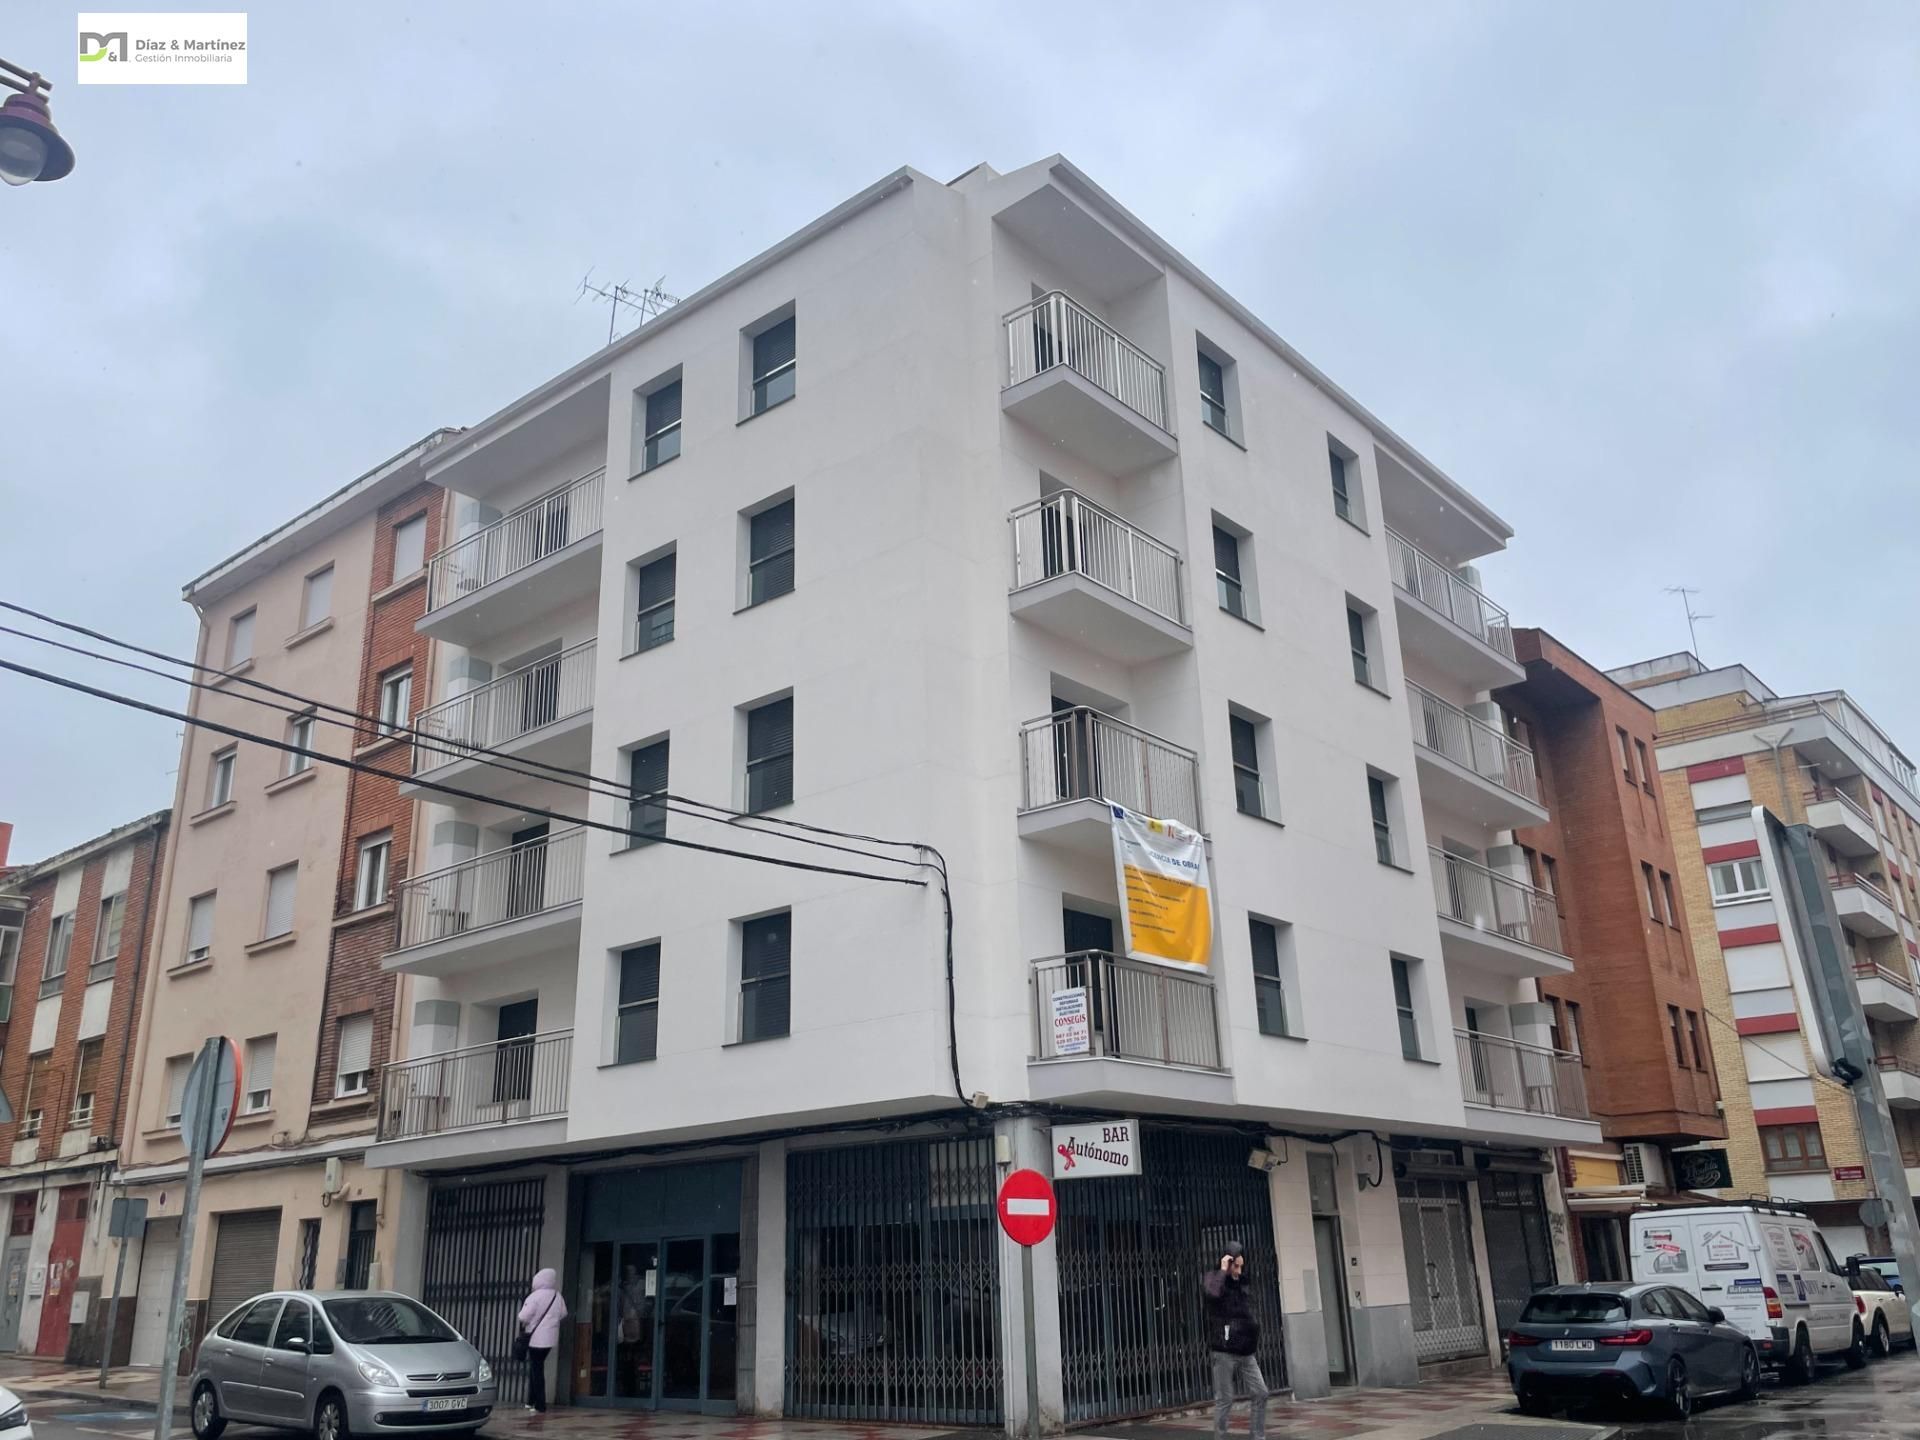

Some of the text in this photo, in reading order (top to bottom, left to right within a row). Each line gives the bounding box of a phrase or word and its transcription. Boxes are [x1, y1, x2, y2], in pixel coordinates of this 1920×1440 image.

[1055, 1014, 1086, 1028] CONSEGIS
[1102, 1126, 1130, 1143] BAR
[1066, 1136, 1129, 1167] Autónomo
[1554, 1340, 1593, 1349] 1180 LMD
[429, 1400, 450, 1409] 3007
